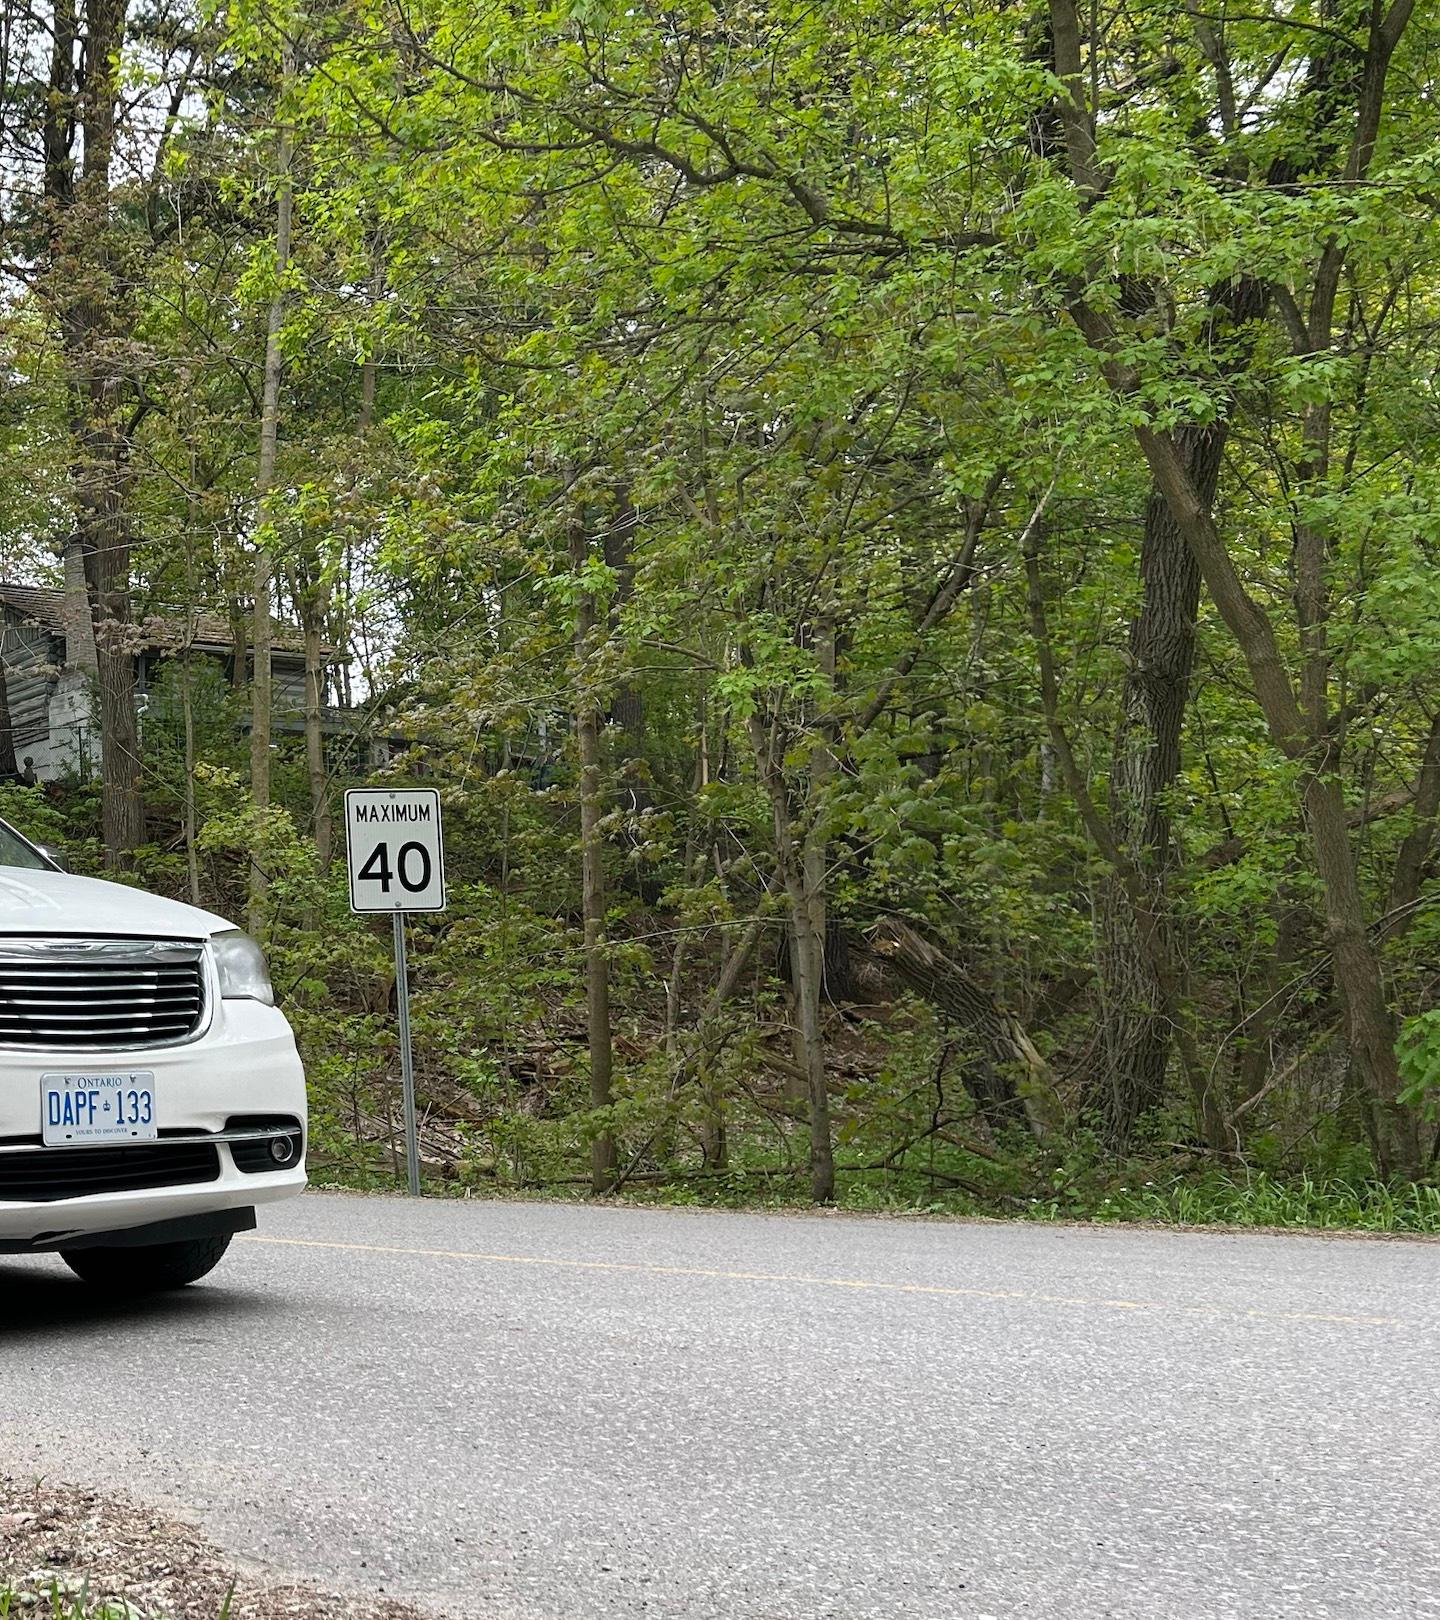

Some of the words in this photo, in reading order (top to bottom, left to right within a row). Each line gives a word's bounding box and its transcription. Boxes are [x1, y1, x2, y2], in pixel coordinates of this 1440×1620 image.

[356, 804, 431, 823] MAXIMUM
[358, 841, 431, 893] 40
[77, 1077, 122, 1089] ONTARIO
[48, 1090, 100, 1126] DAPF
[116, 1090, 152, 1124] 133
